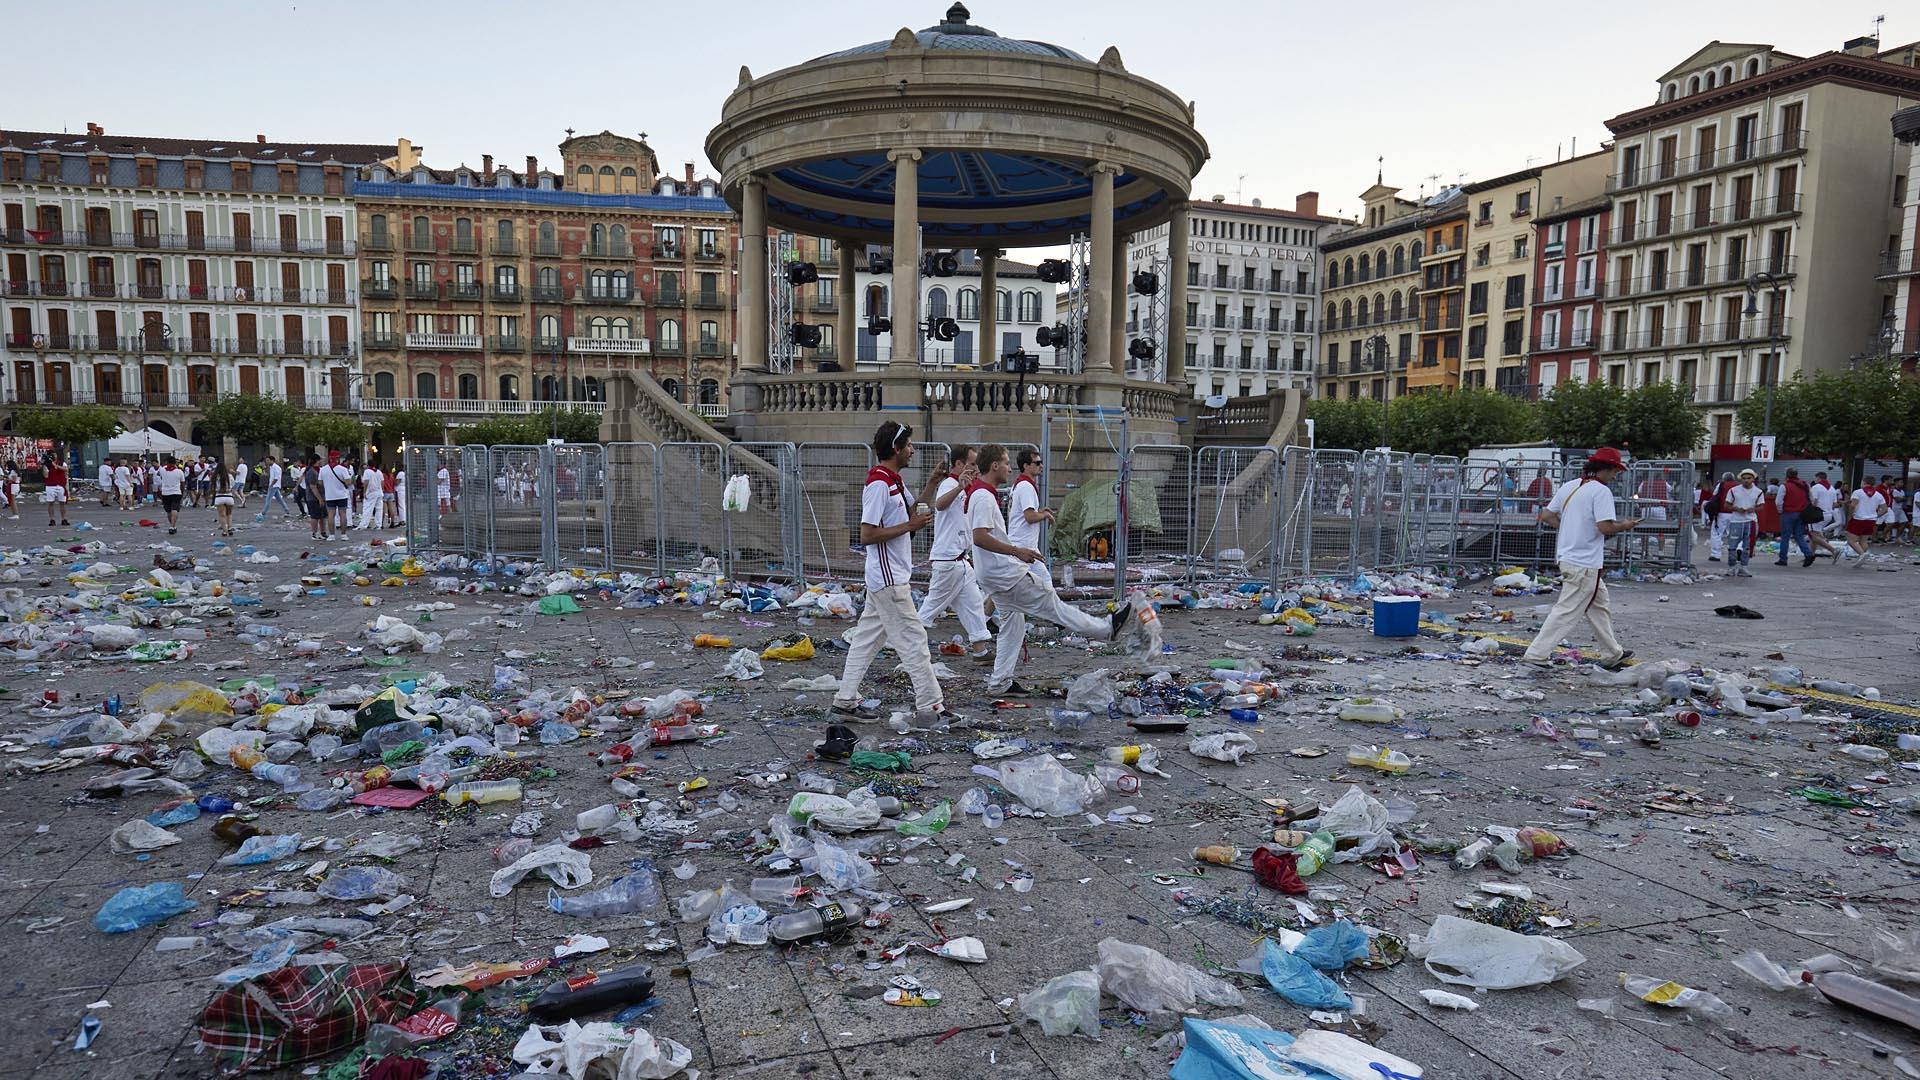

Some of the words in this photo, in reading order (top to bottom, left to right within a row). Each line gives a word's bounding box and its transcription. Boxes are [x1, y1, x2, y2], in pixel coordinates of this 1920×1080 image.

[1132, 243, 1160, 261] HOTEL
[1241, 244, 1260, 258] LA
[1267, 247, 1314, 263] PERLA
